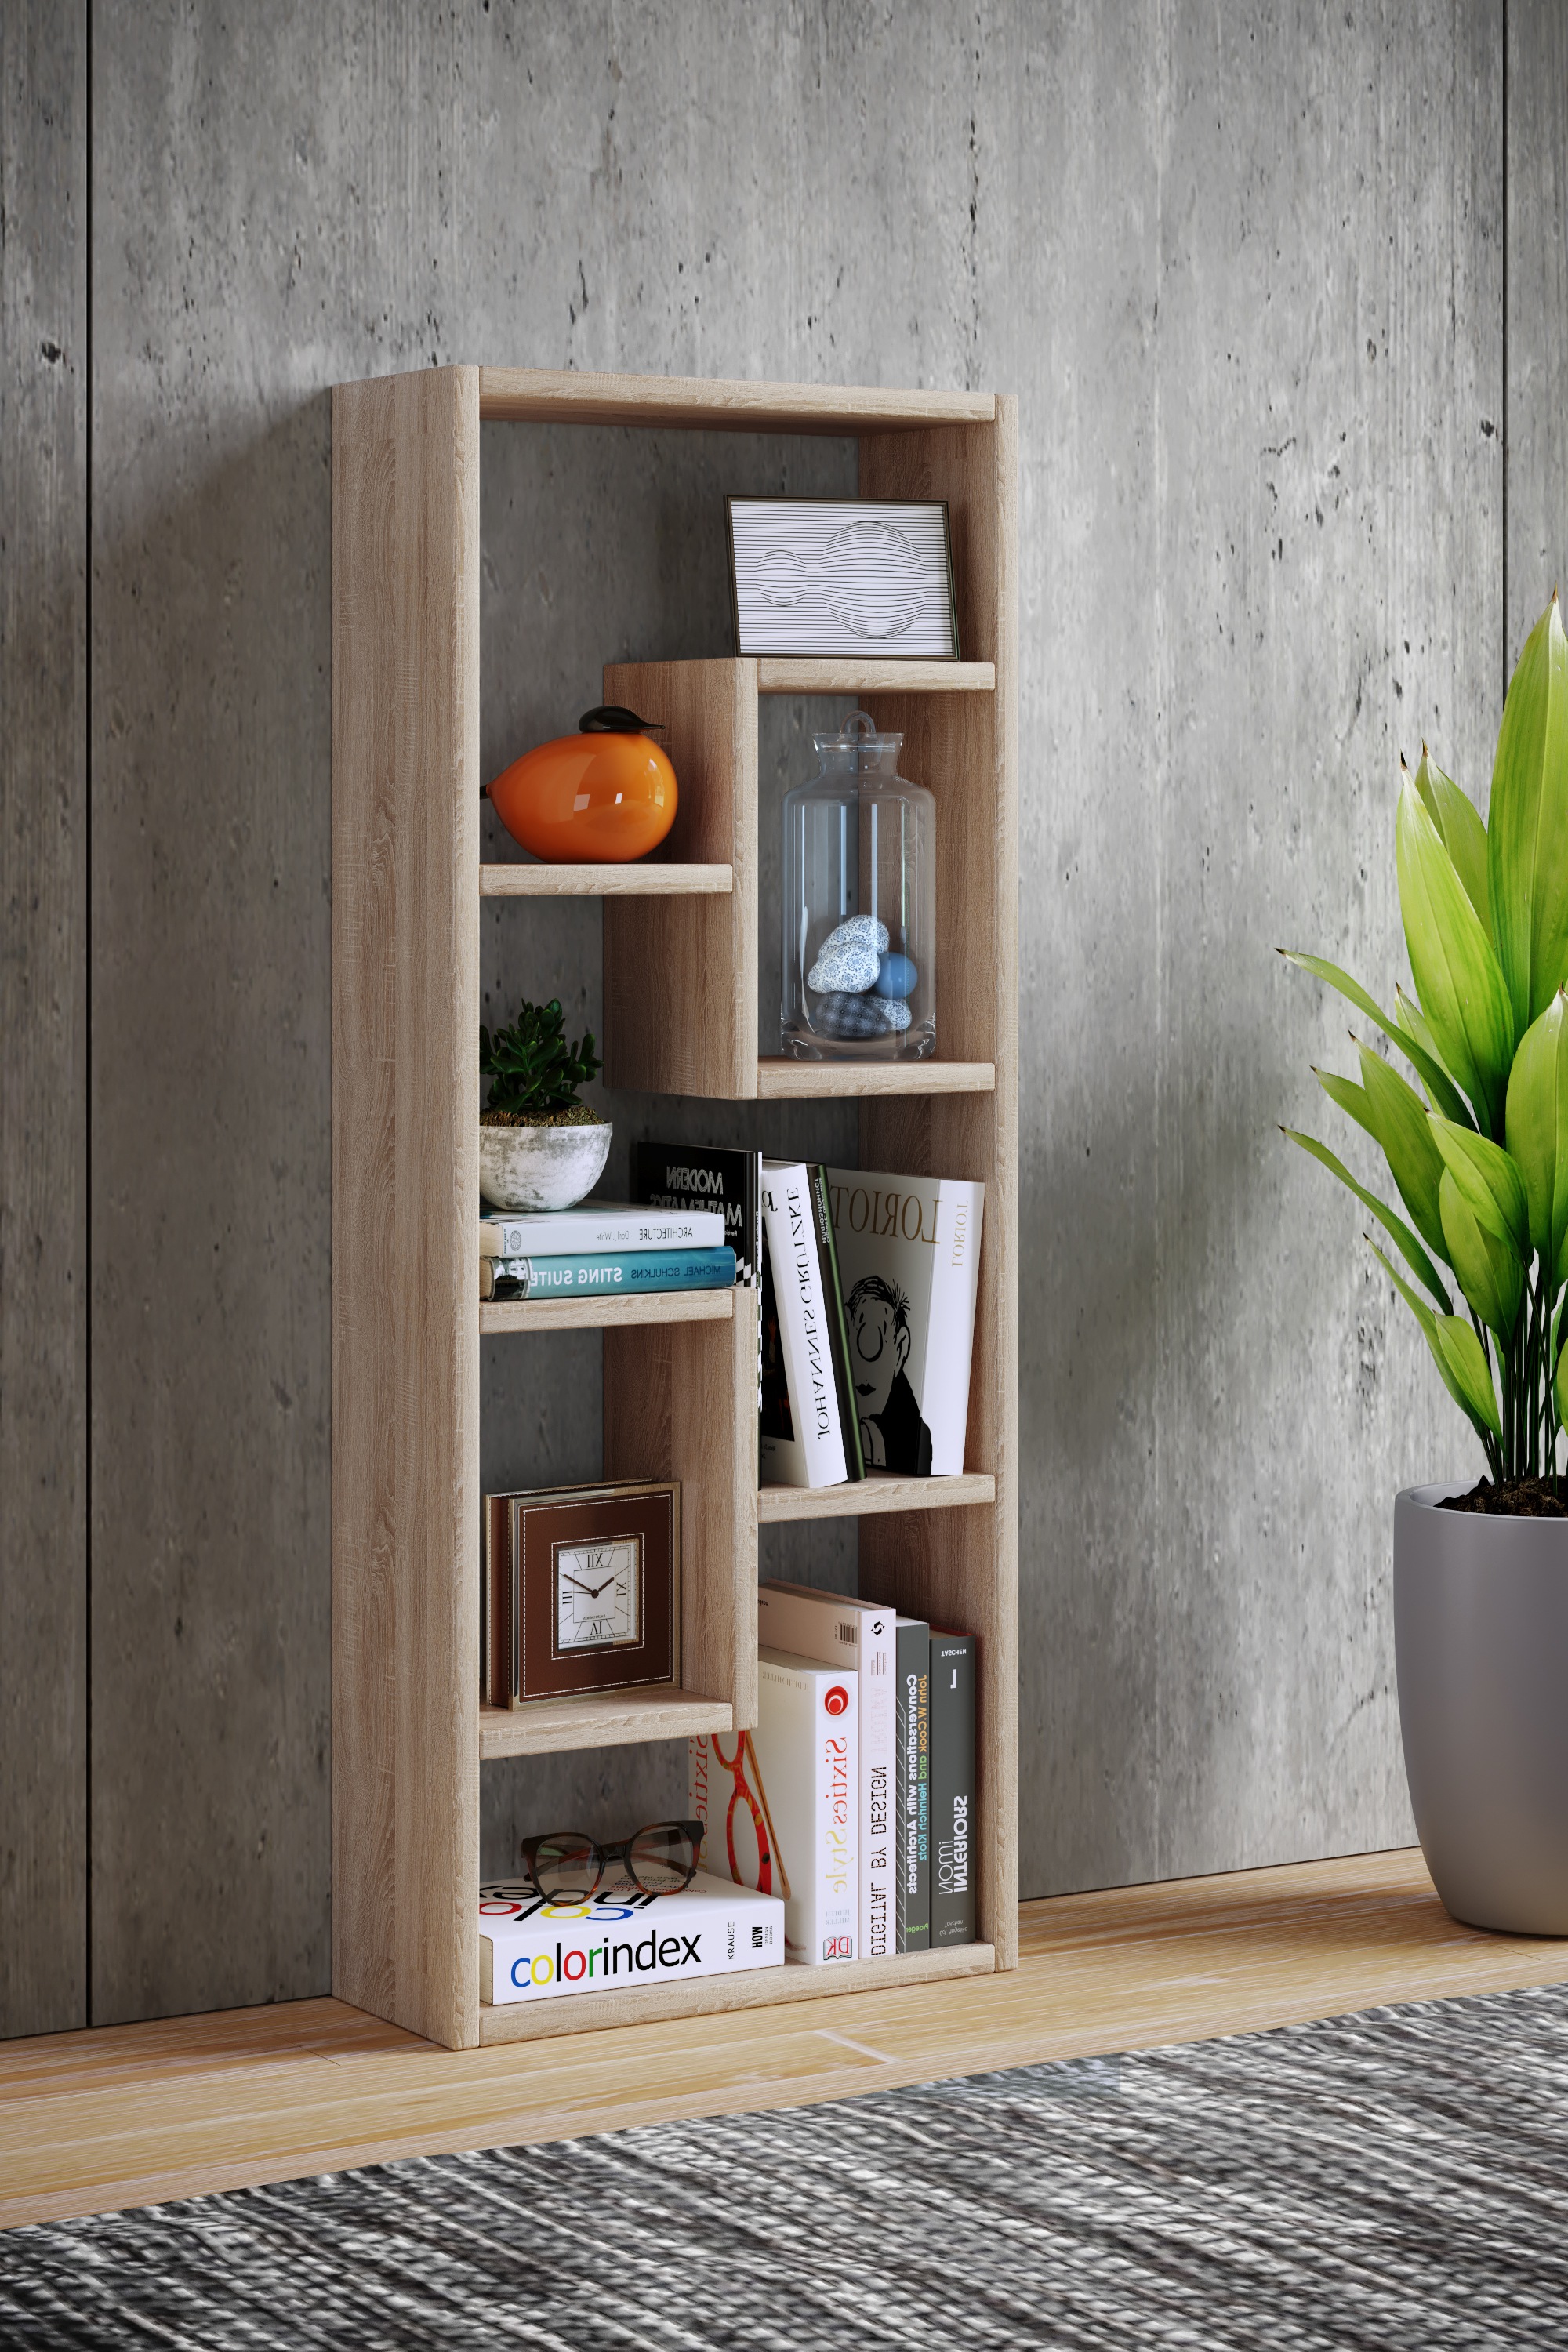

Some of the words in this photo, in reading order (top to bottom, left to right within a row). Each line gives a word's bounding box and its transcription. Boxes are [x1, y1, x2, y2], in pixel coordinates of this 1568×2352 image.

[479, 1901, 634, 1922] colo
[752, 1926, 763, 1948] HOW
[510, 1929, 702, 1987] colorindex
